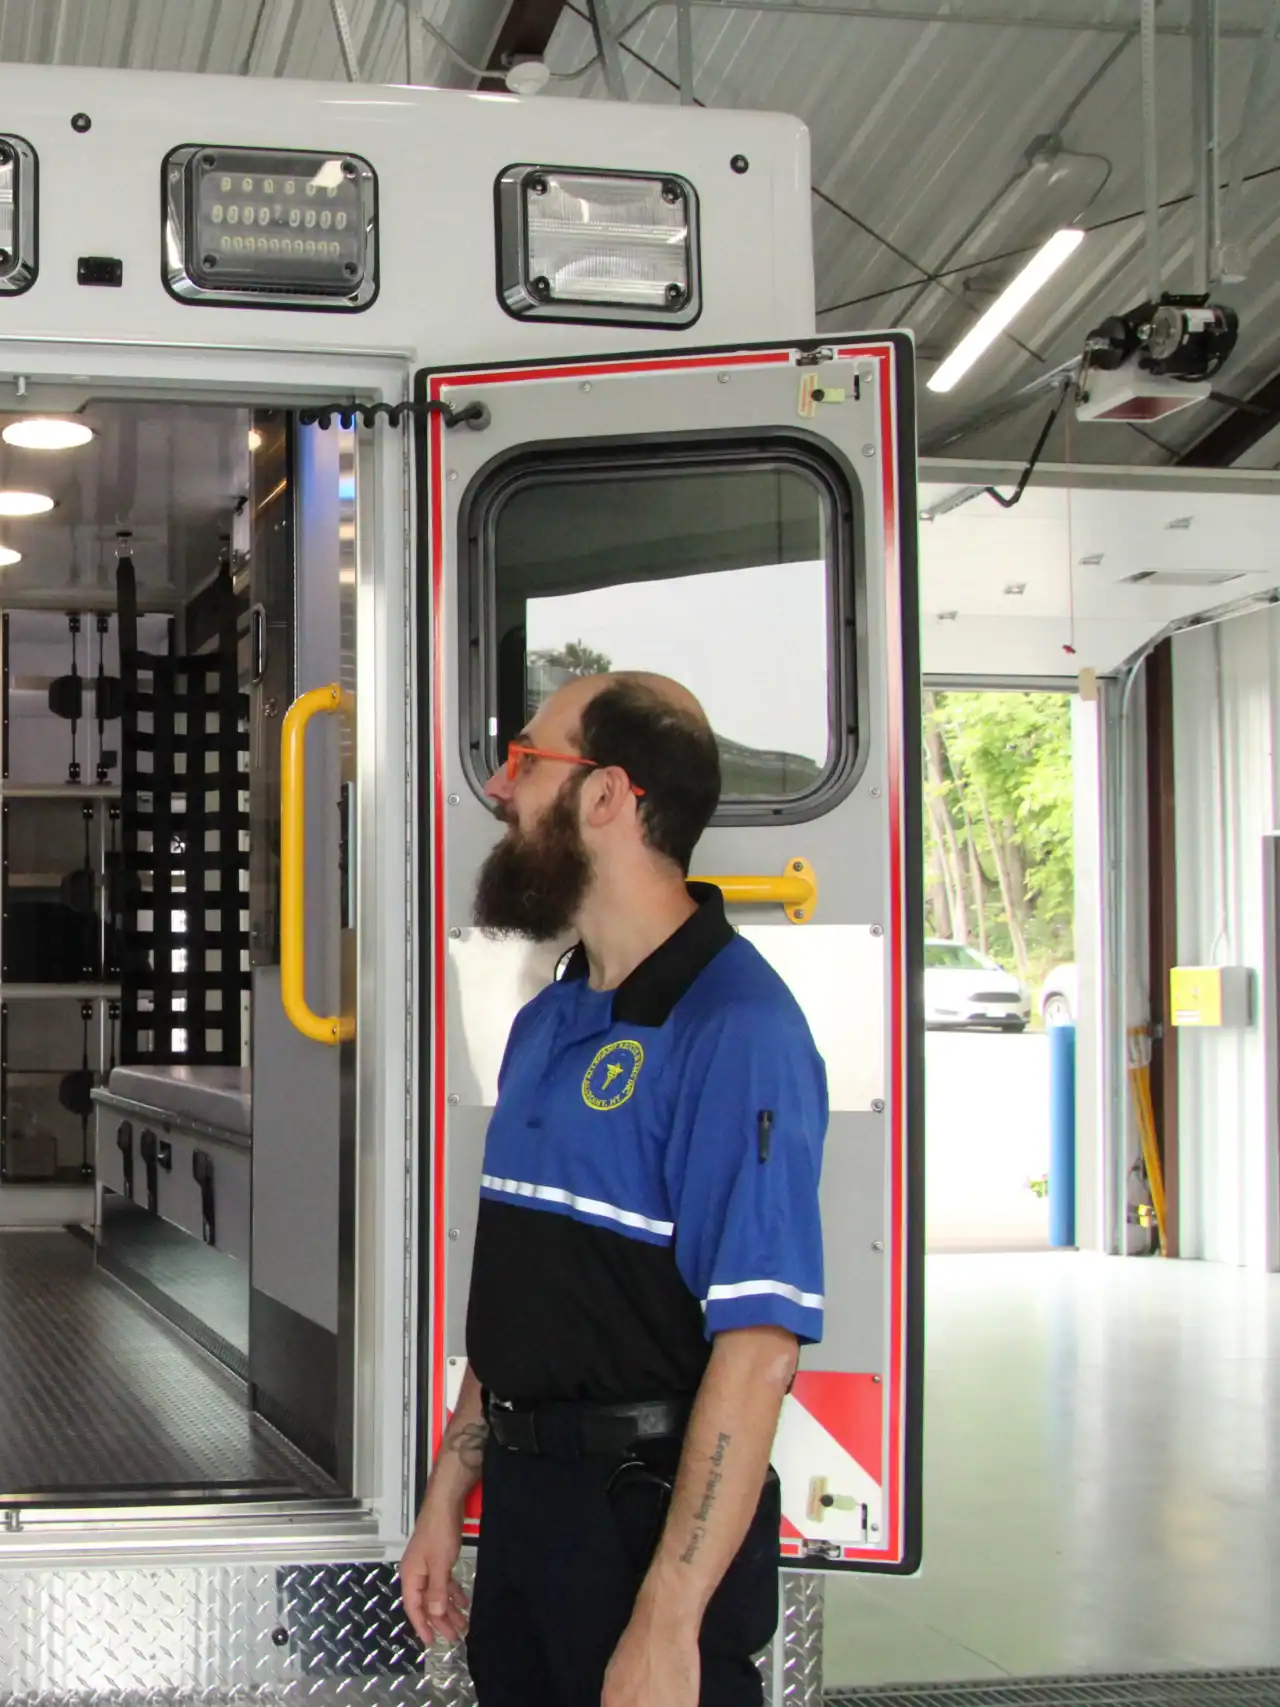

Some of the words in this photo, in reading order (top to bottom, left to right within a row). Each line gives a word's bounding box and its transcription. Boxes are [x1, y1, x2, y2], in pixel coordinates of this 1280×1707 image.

[709, 1431, 731, 1466] Keep
[693, 1468, 723, 1522] Fucking
[680, 1526, 706, 1566] Going
